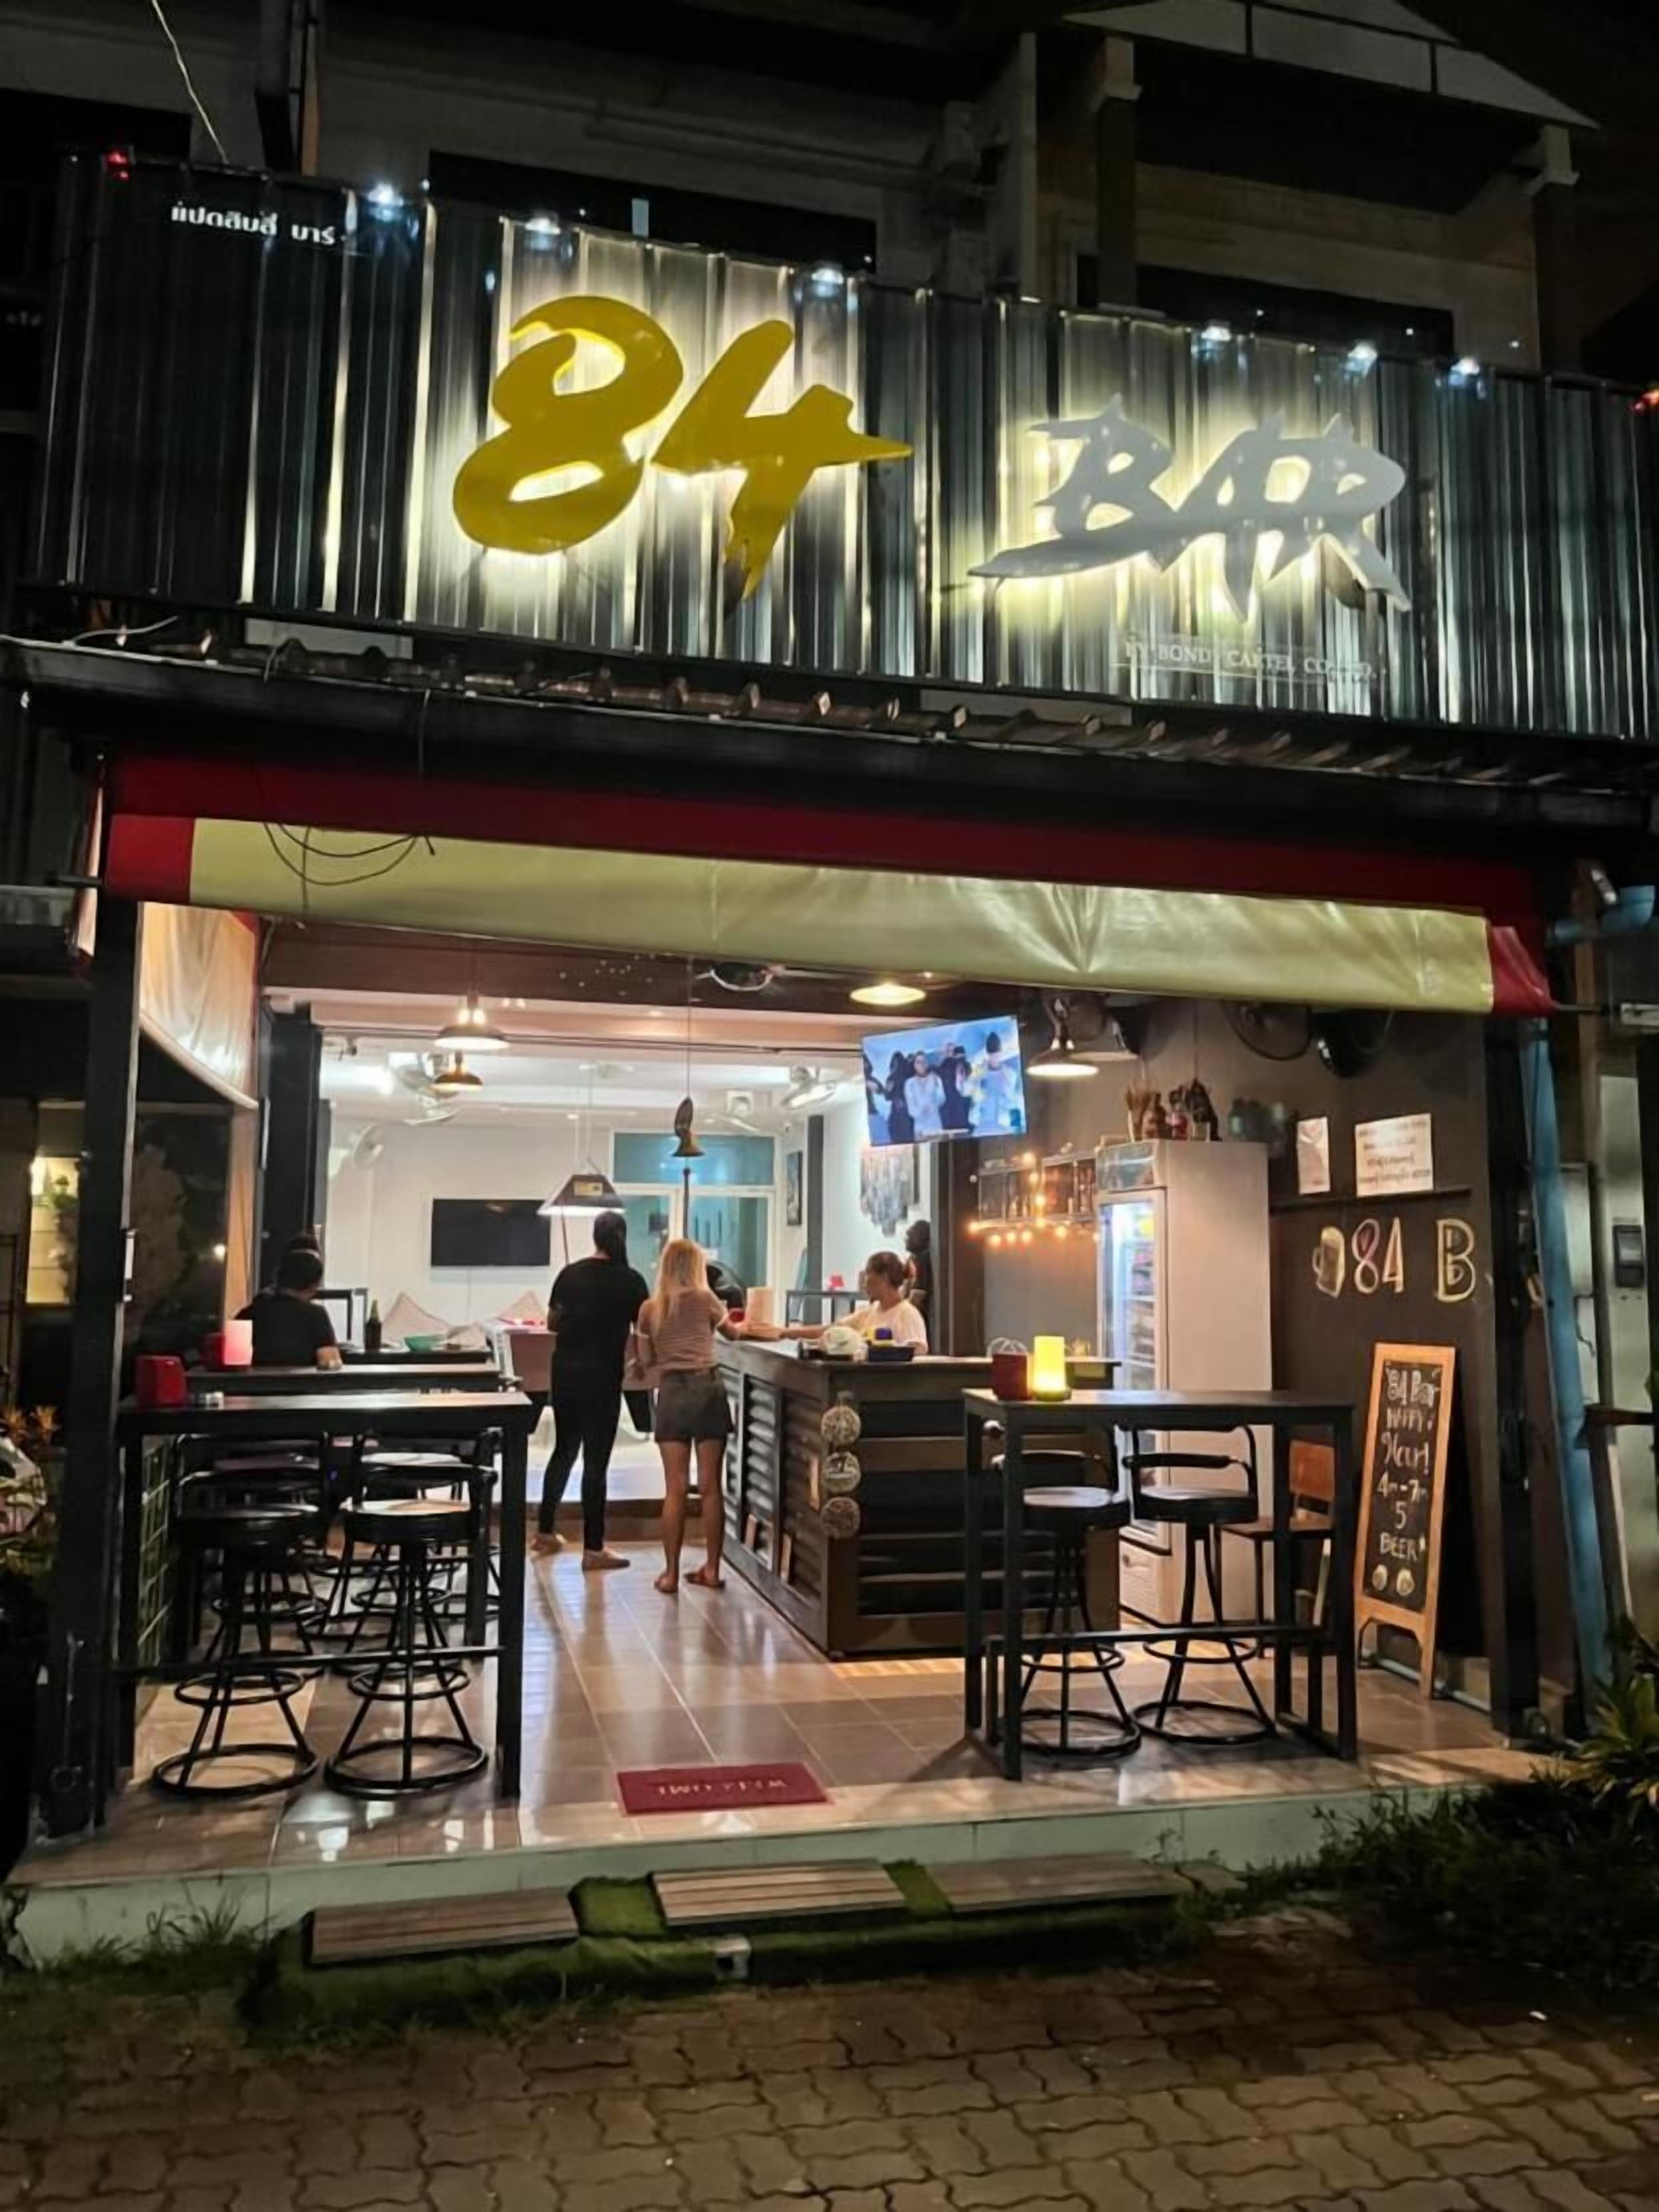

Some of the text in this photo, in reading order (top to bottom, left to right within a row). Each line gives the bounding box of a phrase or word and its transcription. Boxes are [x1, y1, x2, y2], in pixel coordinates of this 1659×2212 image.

[453, 295, 1412, 623] 84 BAR
[1158, 642, 1212, 664] BOND
[1351, 1217, 1405, 1294] 84
